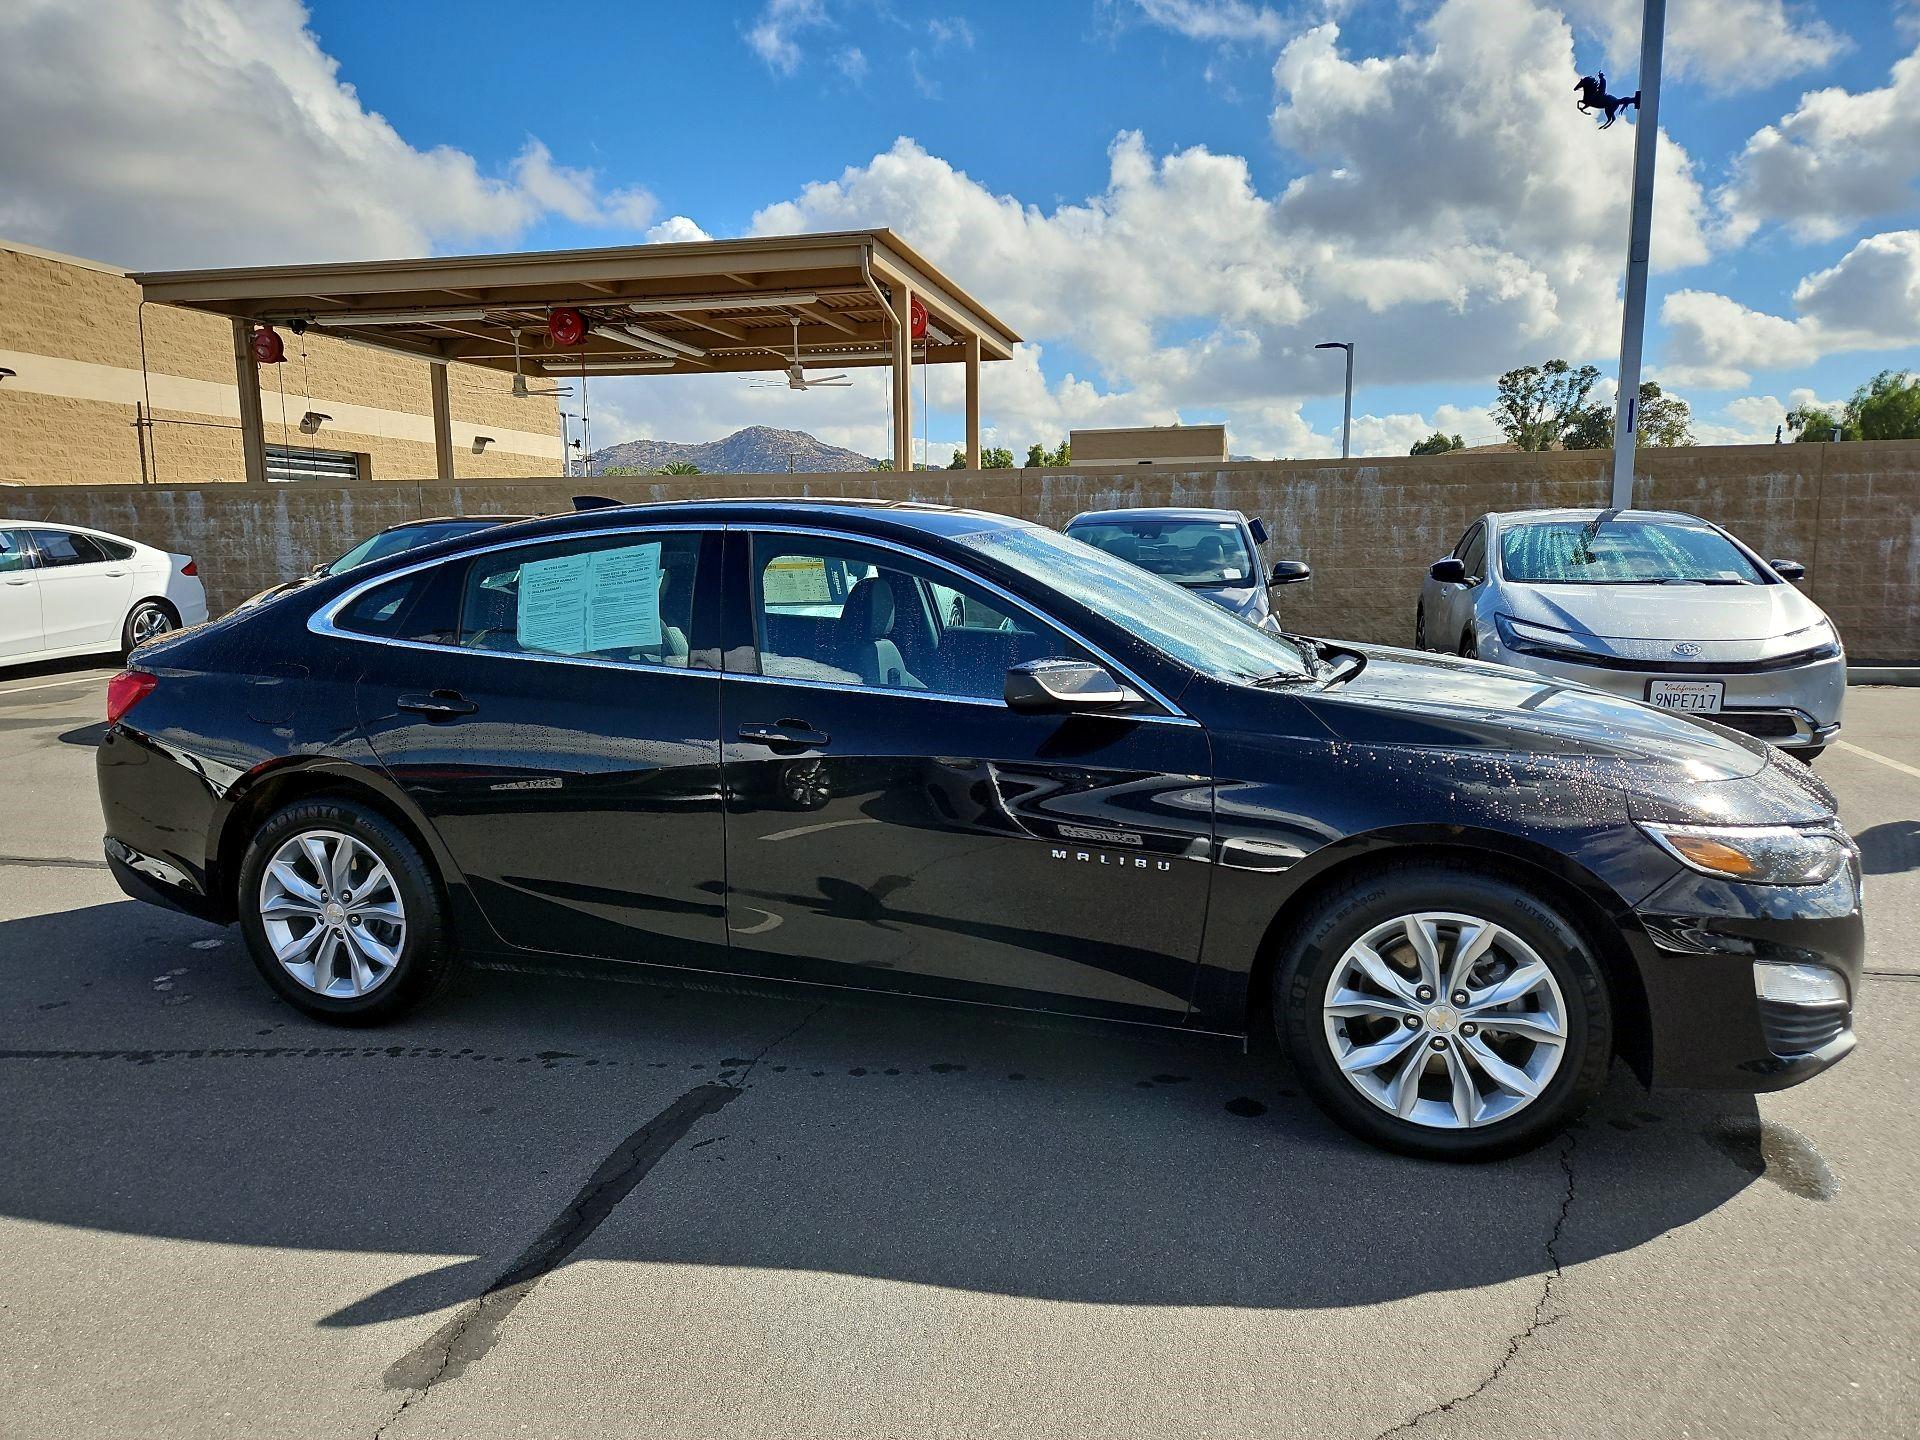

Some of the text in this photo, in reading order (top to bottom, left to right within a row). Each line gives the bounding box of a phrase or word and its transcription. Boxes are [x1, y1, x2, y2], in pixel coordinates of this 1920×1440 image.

[1665, 683, 1705, 694] California
[1655, 693, 1717, 709] 9NPE717
[1051, 849, 1170, 871] MALIBU
[1316, 889, 1386, 943] ALL SEASON
[1515, 898, 1562, 937] OUTSIDE
